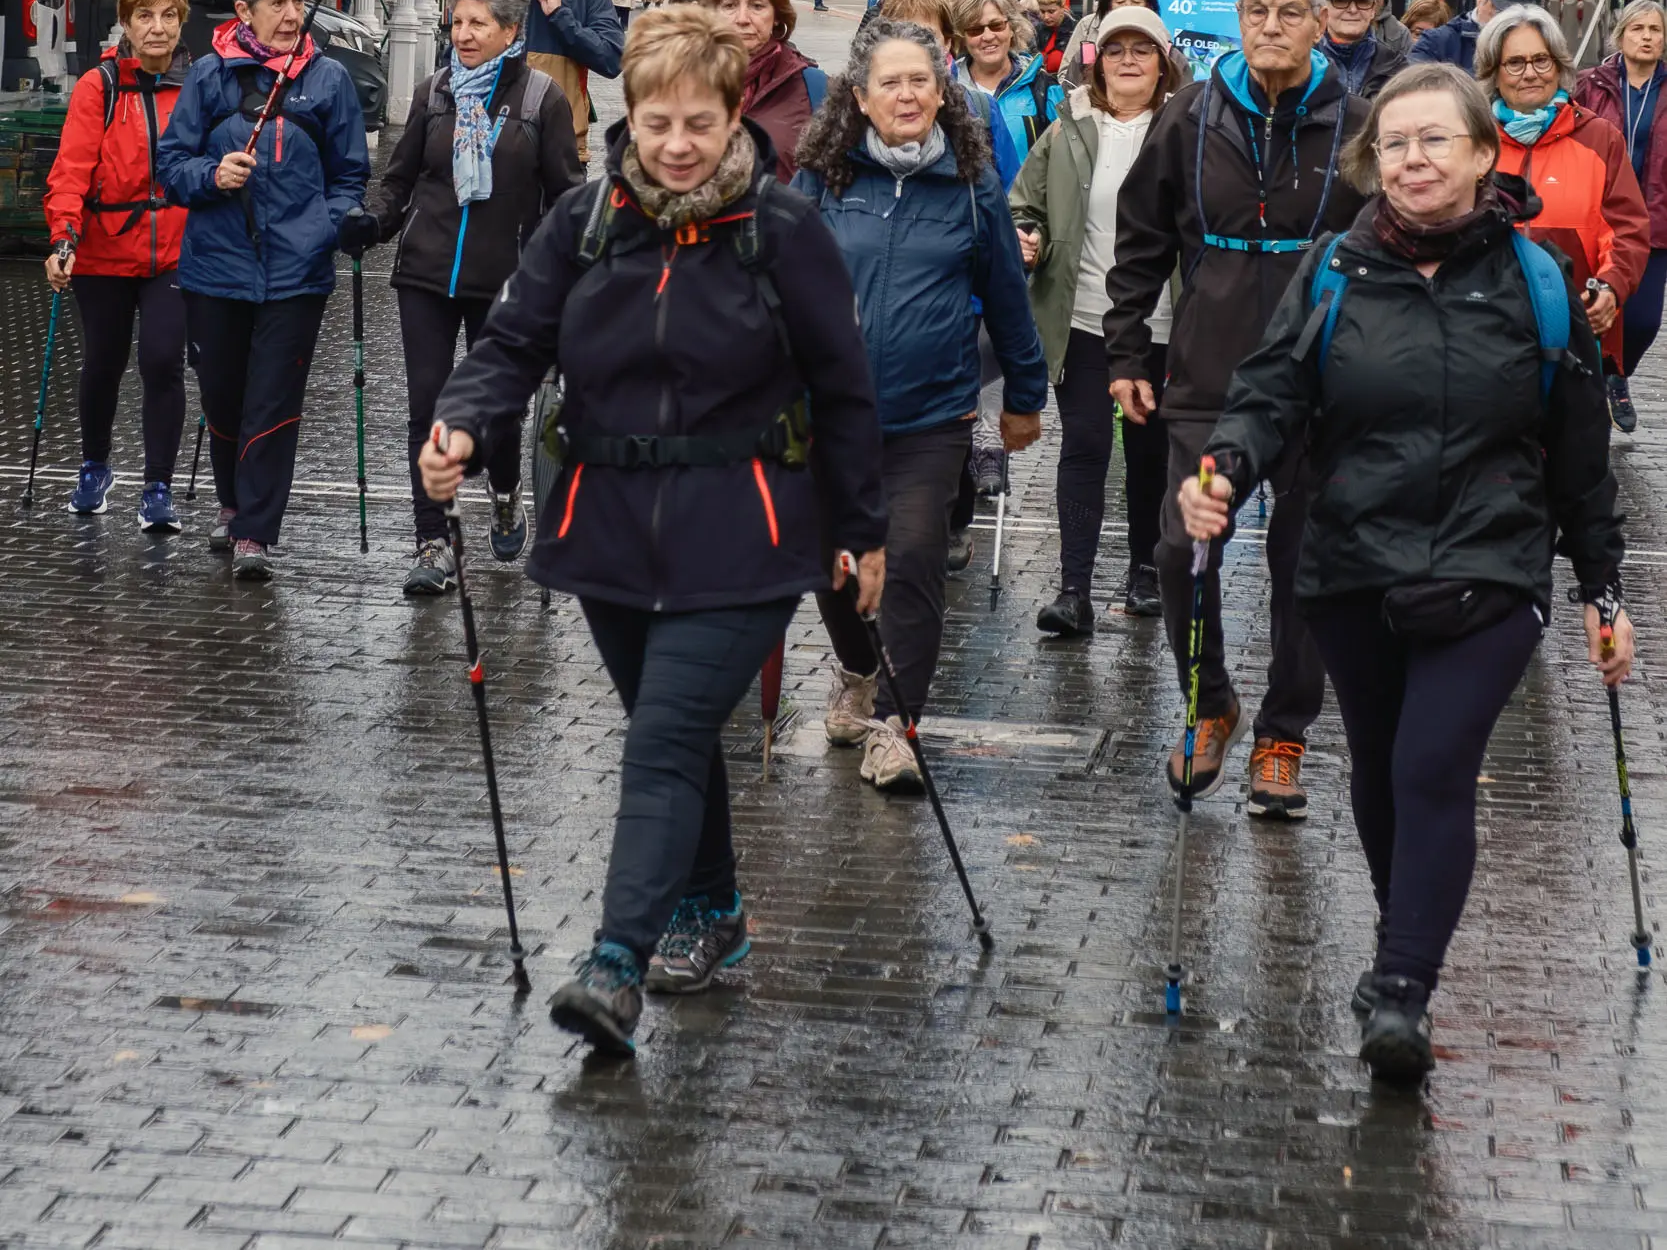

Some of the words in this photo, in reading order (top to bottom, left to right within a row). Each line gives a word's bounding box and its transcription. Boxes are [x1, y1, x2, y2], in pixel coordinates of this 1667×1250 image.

[1168, 0, 1192, 15] 40
[1175, 37, 1191, 47] LG
[1194, 39, 1220, 49] OLED
